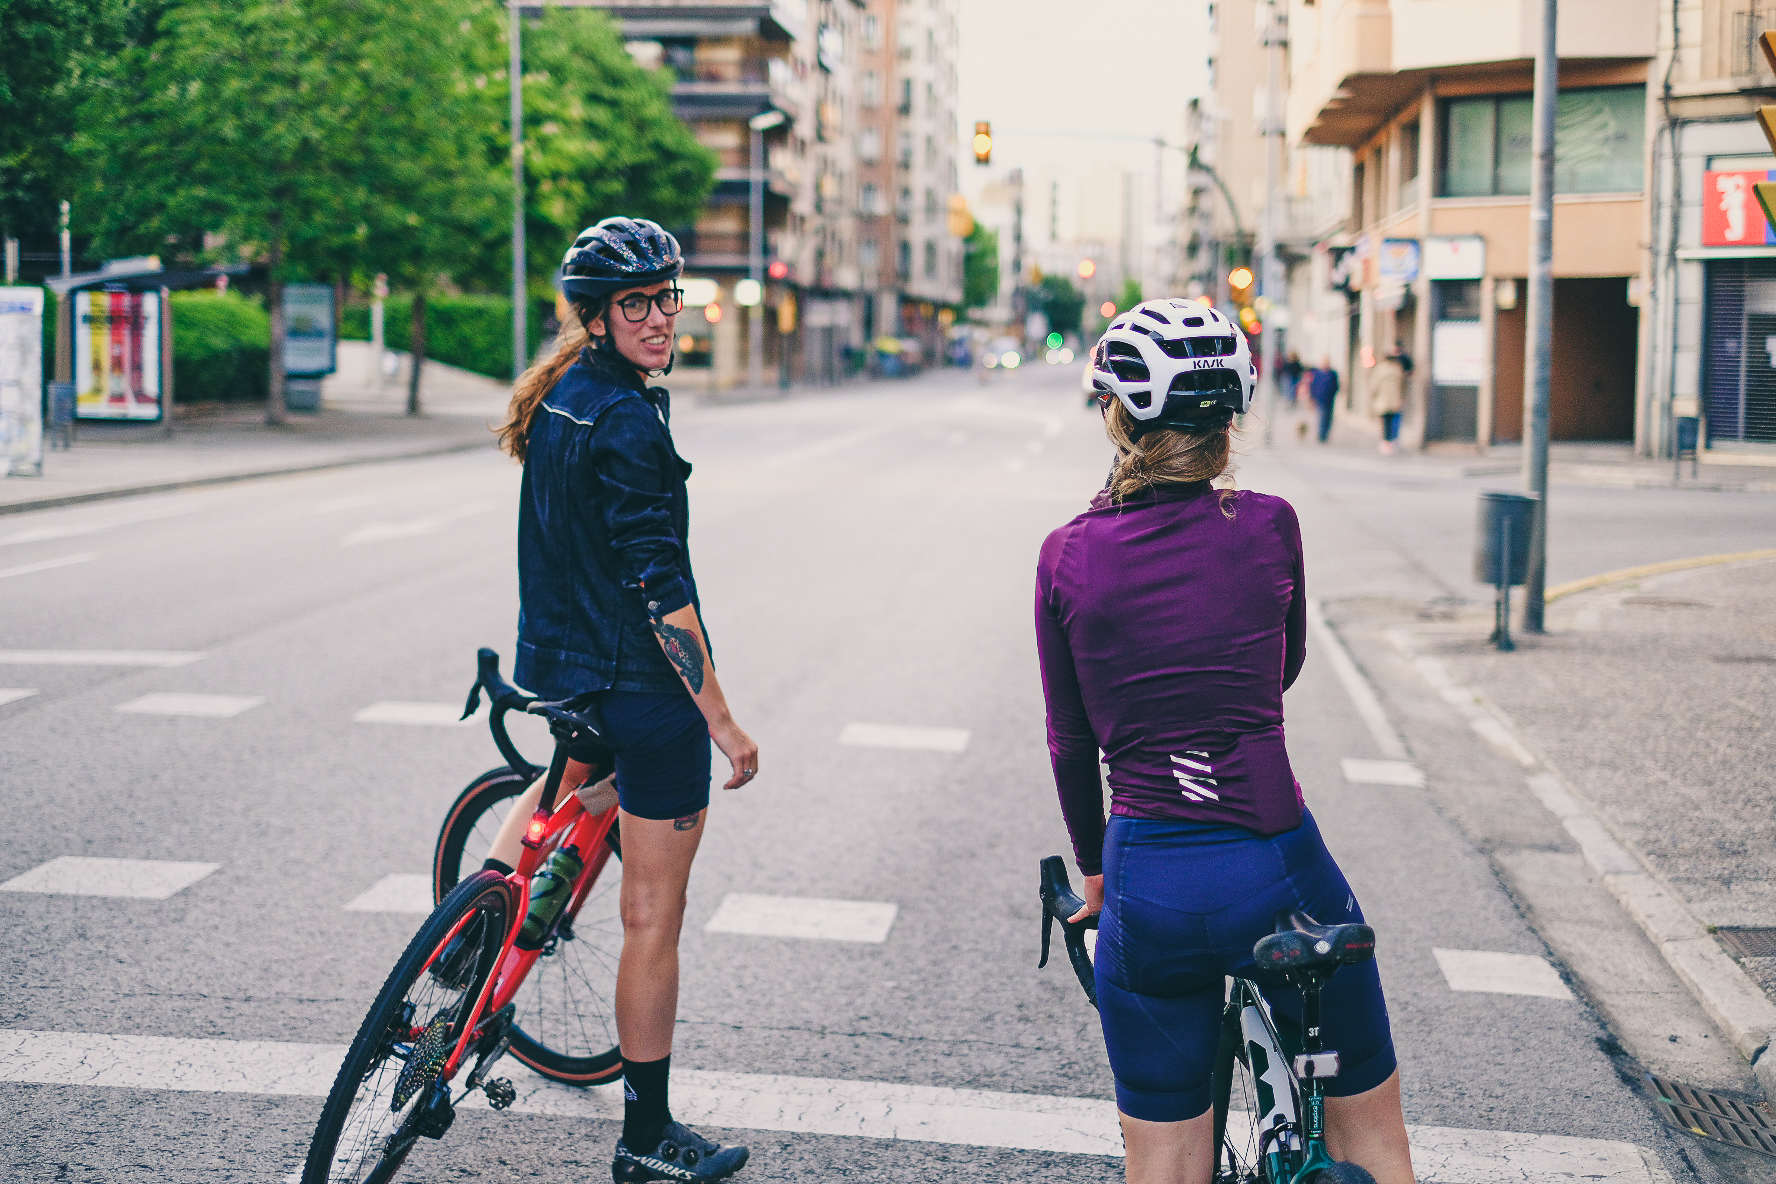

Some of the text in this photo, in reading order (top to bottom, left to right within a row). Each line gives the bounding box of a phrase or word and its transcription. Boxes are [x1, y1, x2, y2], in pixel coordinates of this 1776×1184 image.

[1193, 359, 1225, 369] KASK
[1308, 1027, 1320, 1037] 3T
[616, 1147, 697, 1180] S-WORKS
